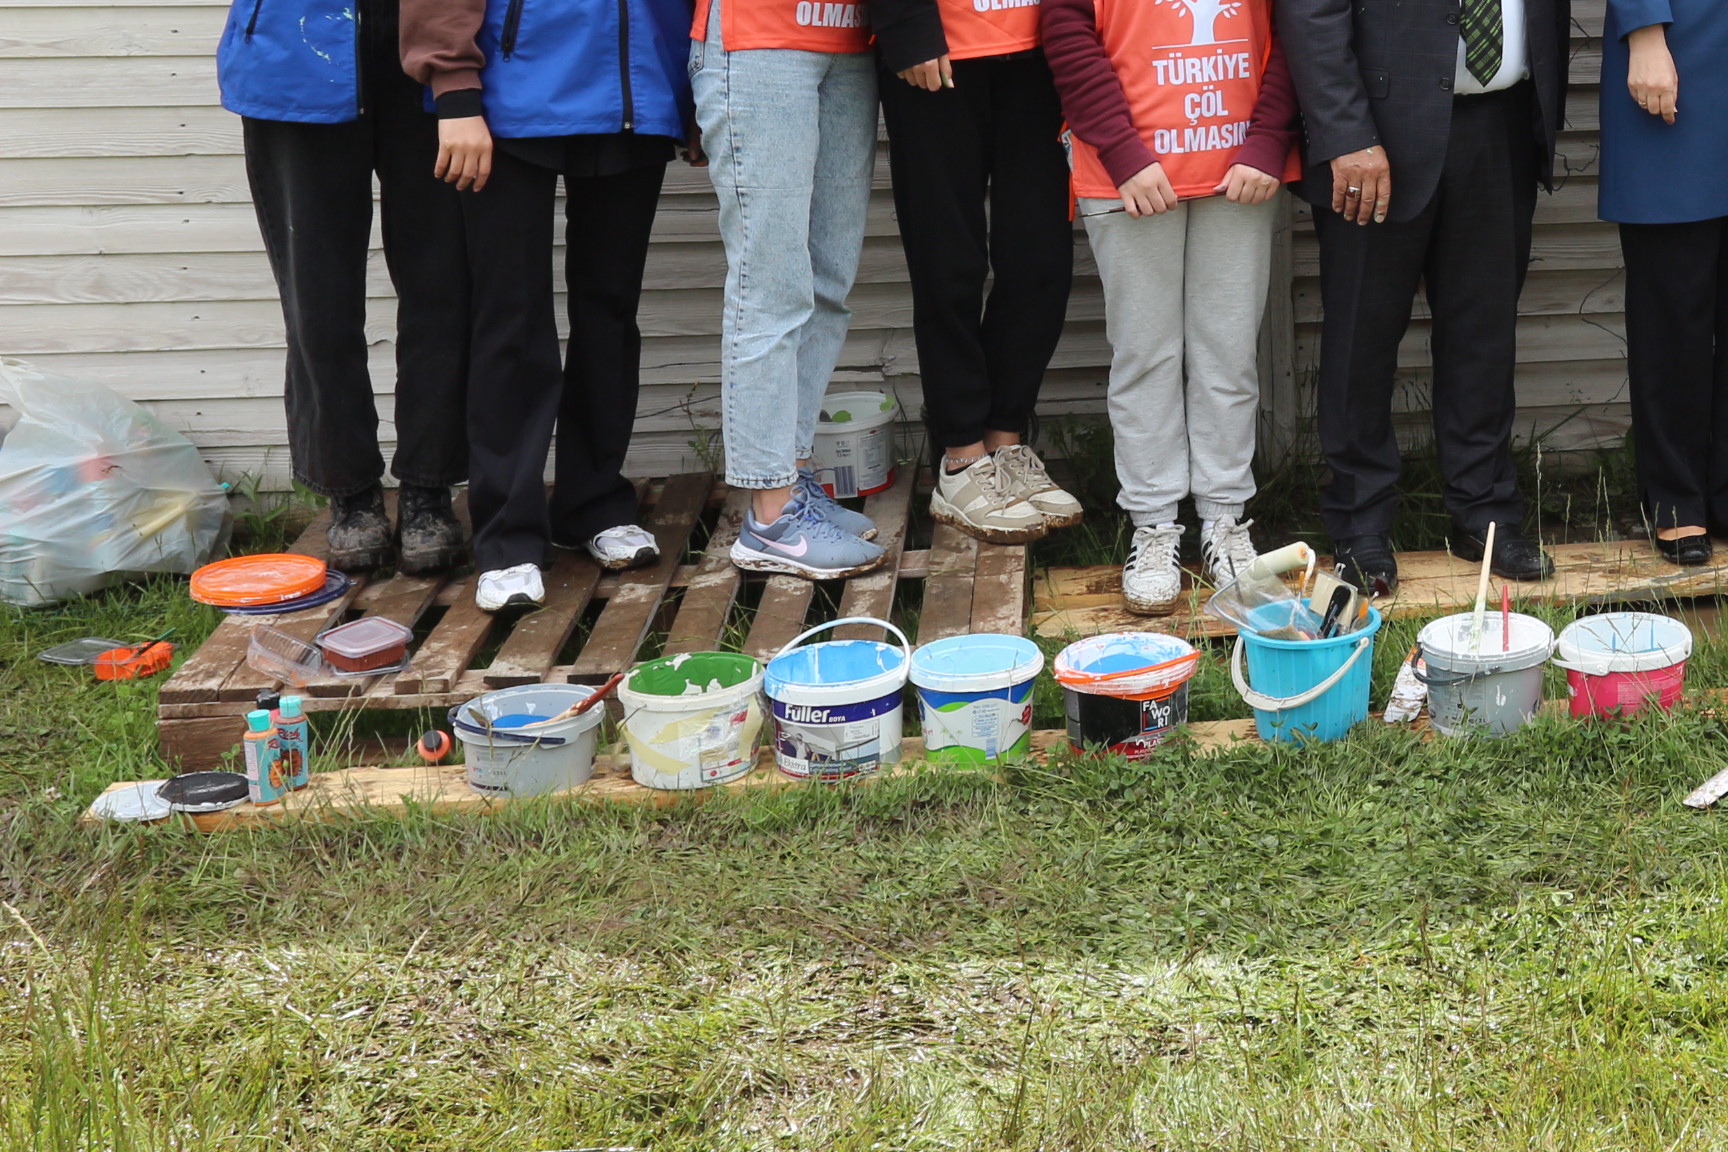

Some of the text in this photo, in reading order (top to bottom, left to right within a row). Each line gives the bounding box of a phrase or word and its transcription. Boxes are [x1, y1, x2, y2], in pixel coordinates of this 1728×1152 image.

[1152, 48, 1251, 86] TÜRKİYE
[1183, 85, 1229, 126] ÇÖL
[784, 704, 831, 723] Füller
[1142, 700, 1158, 712] FA
[1151, 705, 1171, 720] WO
[1157, 716, 1168, 728] RI
